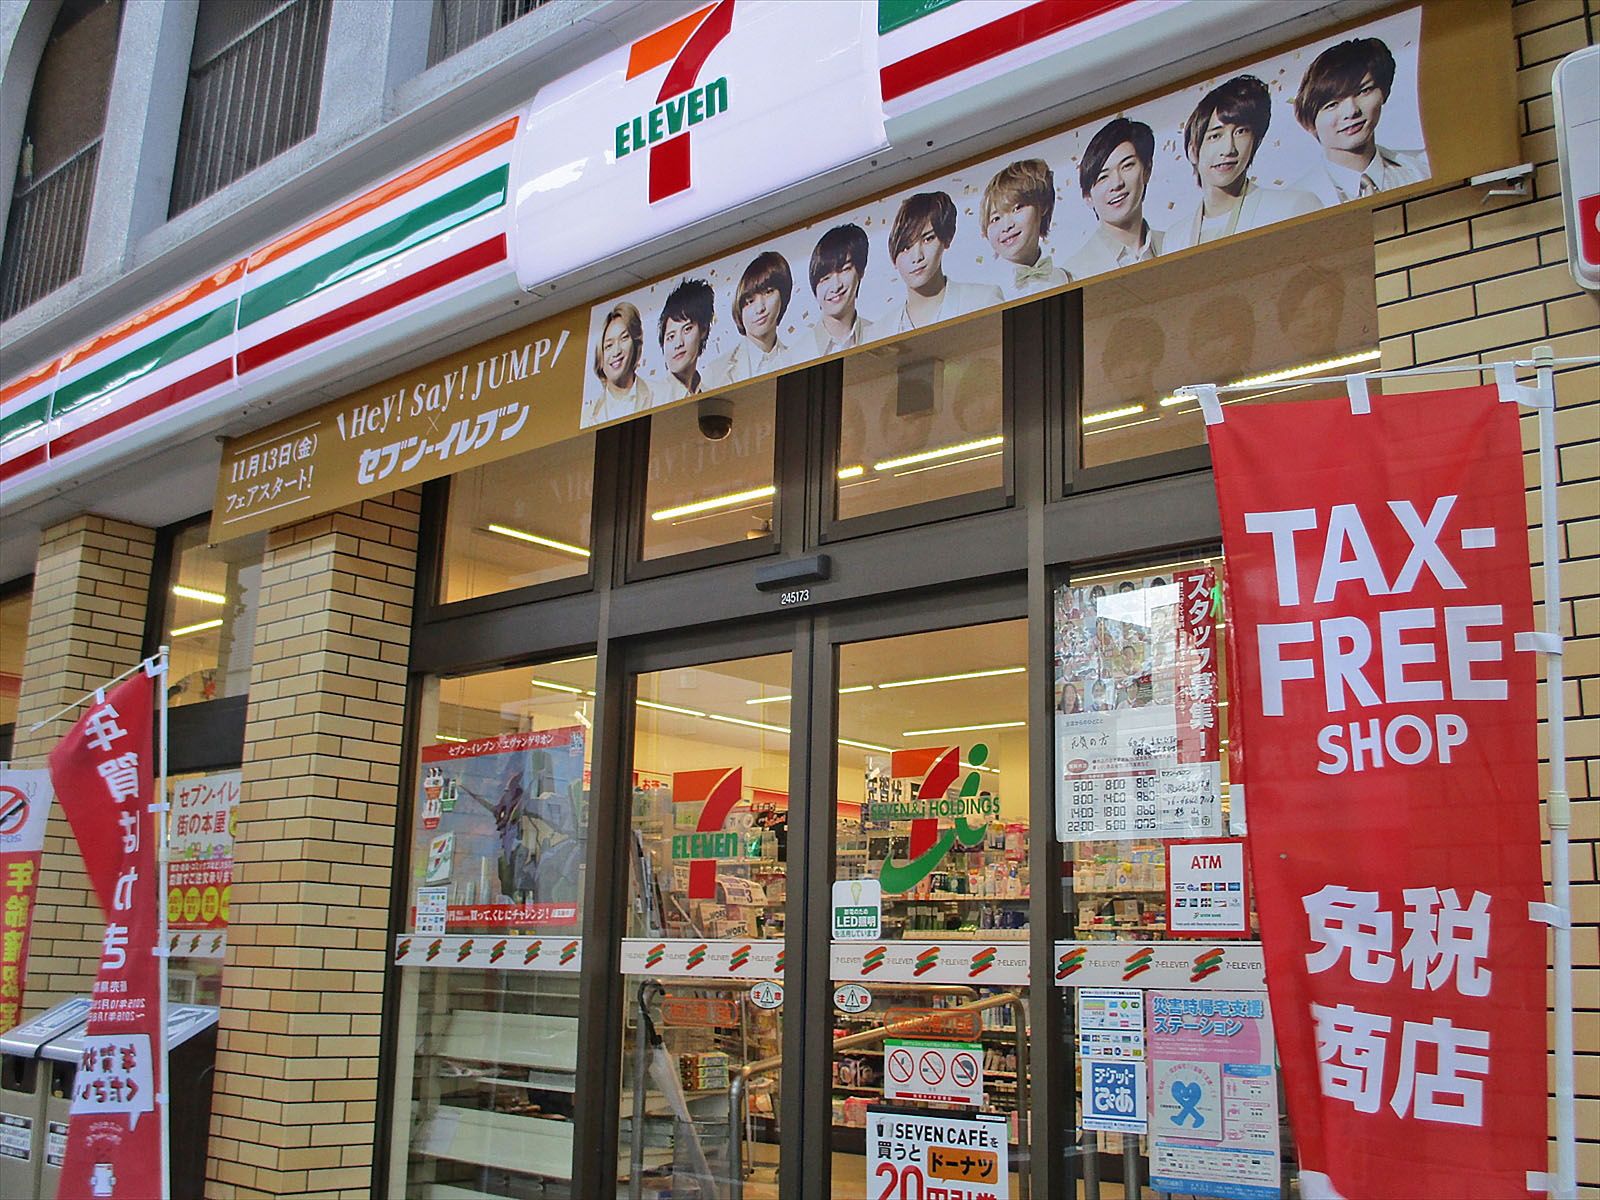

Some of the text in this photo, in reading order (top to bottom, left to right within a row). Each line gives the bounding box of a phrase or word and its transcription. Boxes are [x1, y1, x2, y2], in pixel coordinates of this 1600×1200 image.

[472, 338, 551, 400] JUMP
[1244, 494, 1496, 607] TAX-
[781, 589, 810, 605] 245173
[1256, 604, 1509, 717] FREE
[1316, 714, 1469, 775] SHOP
[930, 797, 1000, 818] HOLDINGS
[177, 810, 227, 837] 街の本屋
[1191, 855, 1222, 869] ATM
[836, 915, 877, 928] LED照明
[1301, 884, 1492, 997] 免税
[1153, 997, 1264, 1018] 災害時帰宅支援
[1153, 1016, 1243, 1037] ステーション
[1094, 1067, 1135, 1085] チケット
[1311, 1001, 1490, 1127] 商店
[1094, 1087, 1134, 1113] ぴあ
[895, 1123, 944, 1143] SEVEN
[947, 1125, 988, 1148] CAFÉ
[877, 1141, 922, 1162] 買うと
[931, 1152, 994, 1177] ドーナツ
